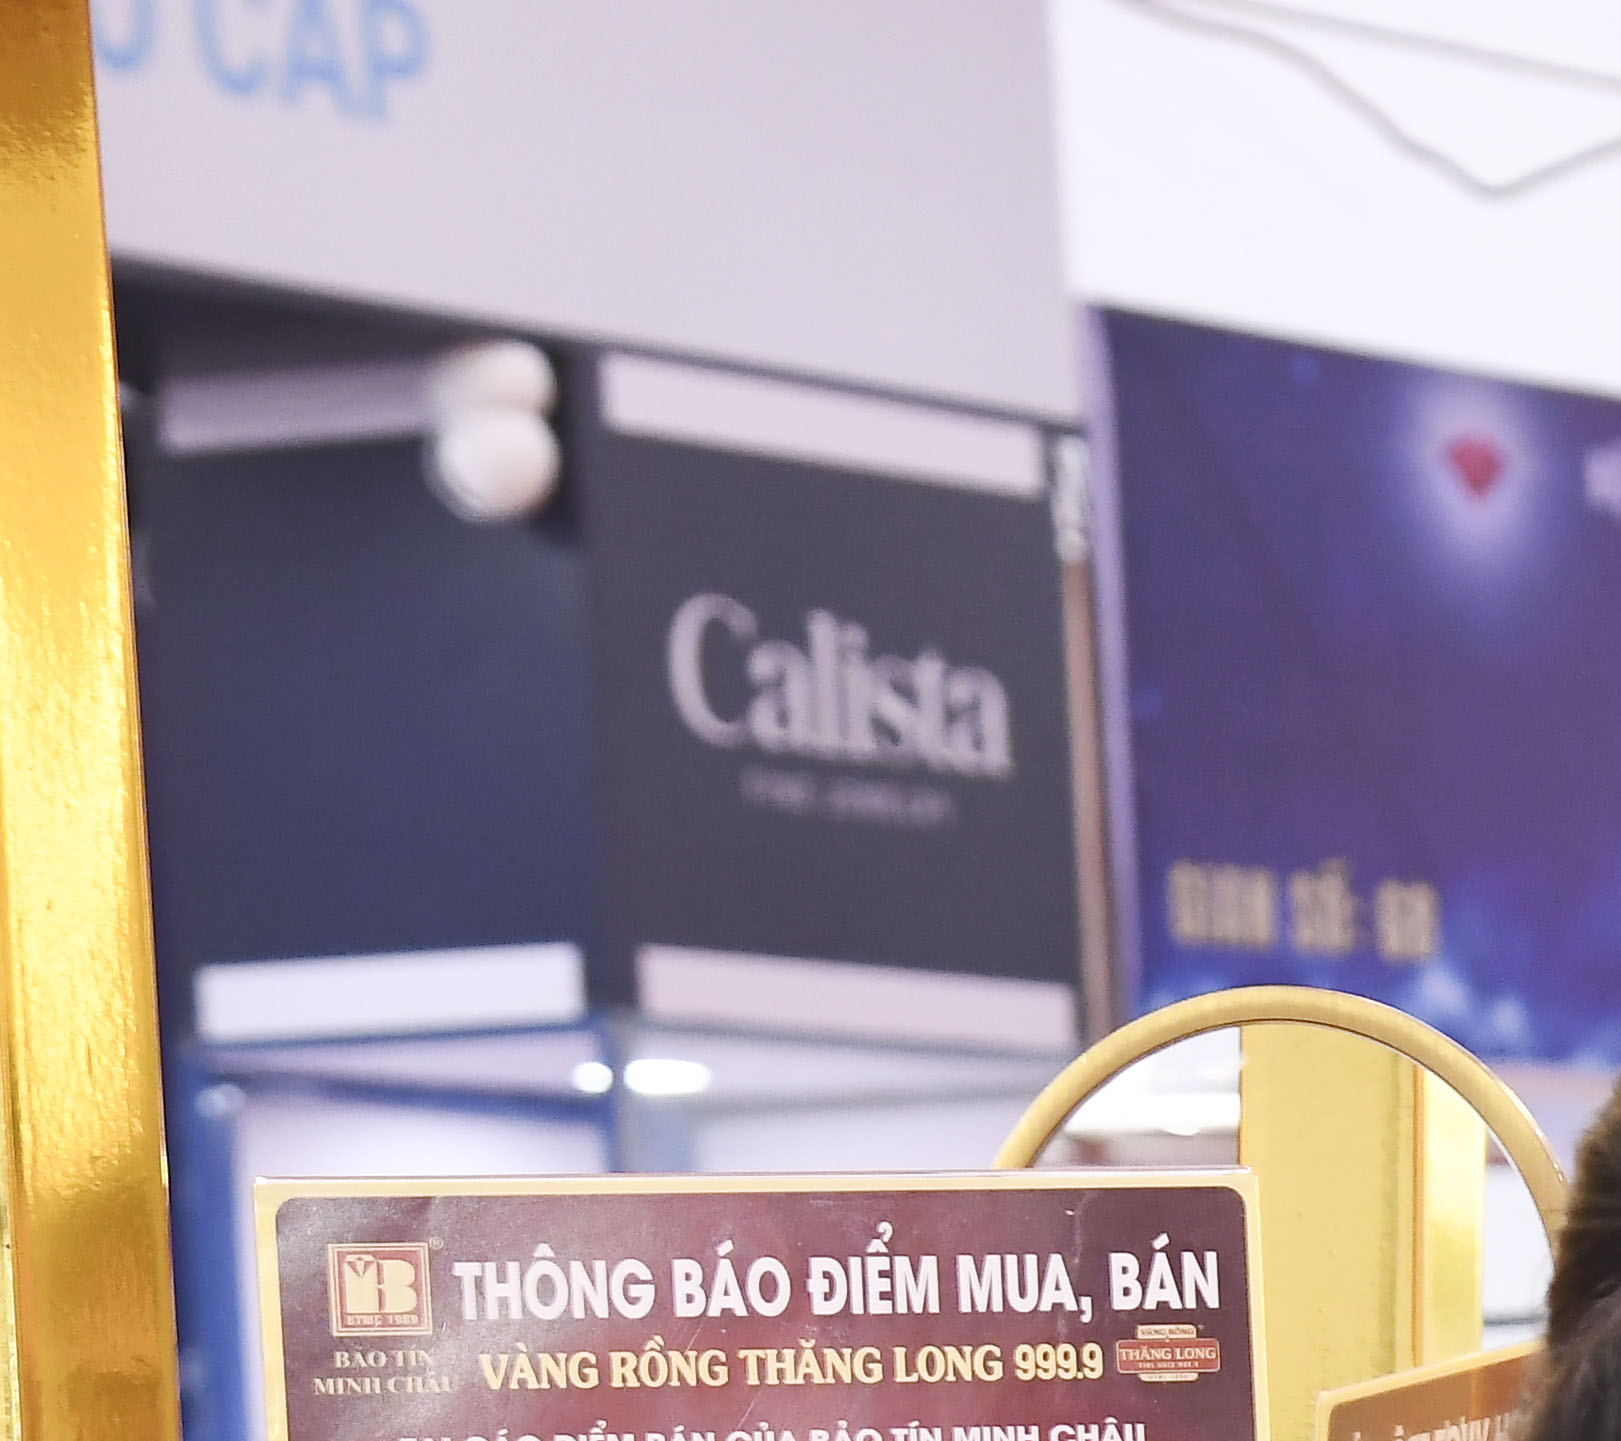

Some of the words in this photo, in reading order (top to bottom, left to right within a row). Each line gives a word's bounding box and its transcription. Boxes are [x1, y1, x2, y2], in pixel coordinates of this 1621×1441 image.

[668, 593, 1014, 779] Calista
[452, 1243, 655, 1321] THÔNG
[671, 1238, 791, 1318] BÁO
[806, 1222, 939, 1315] ĐIỂM
[956, 1252, 1093, 1324] MUA,
[1108, 1231, 1220, 1311] BÁN
[477, 1334, 599, 1390] VÀNG
[607, 1334, 729, 1388] RỒNG
[736, 1337, 883, 1386] THĂNG
[892, 1343, 1004, 1383] LONG
[1012, 1341, 1104, 1381] 999.9
[1175, 1344, 1217, 1361] LONG
